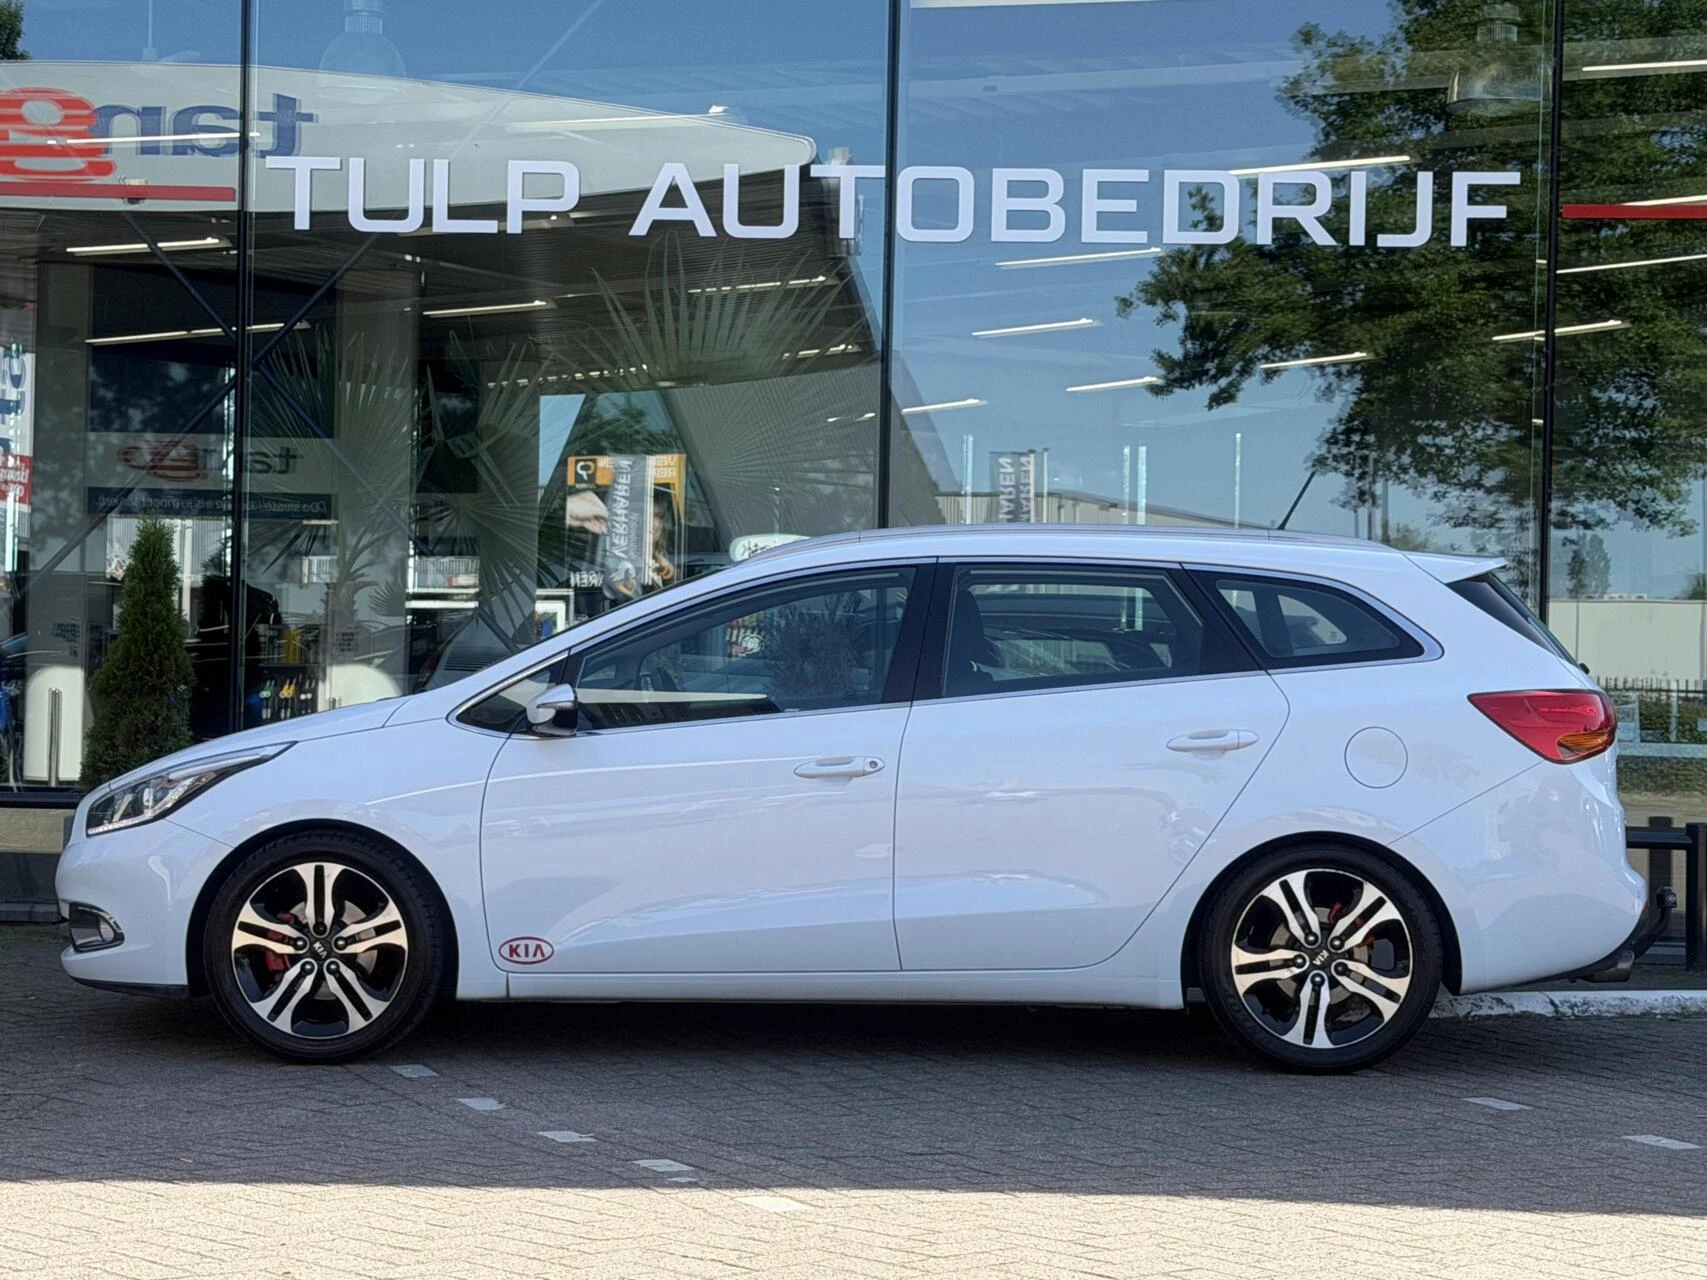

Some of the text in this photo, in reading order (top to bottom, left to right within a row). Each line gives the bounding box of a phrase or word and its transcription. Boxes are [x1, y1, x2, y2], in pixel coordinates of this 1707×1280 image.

[265, 156, 1521, 247] TULP AUTOBEDRIJF
[313, 941, 327, 959] KIA
[508, 943, 546, 958] KIA
[1312, 949, 1329, 966] KIA
